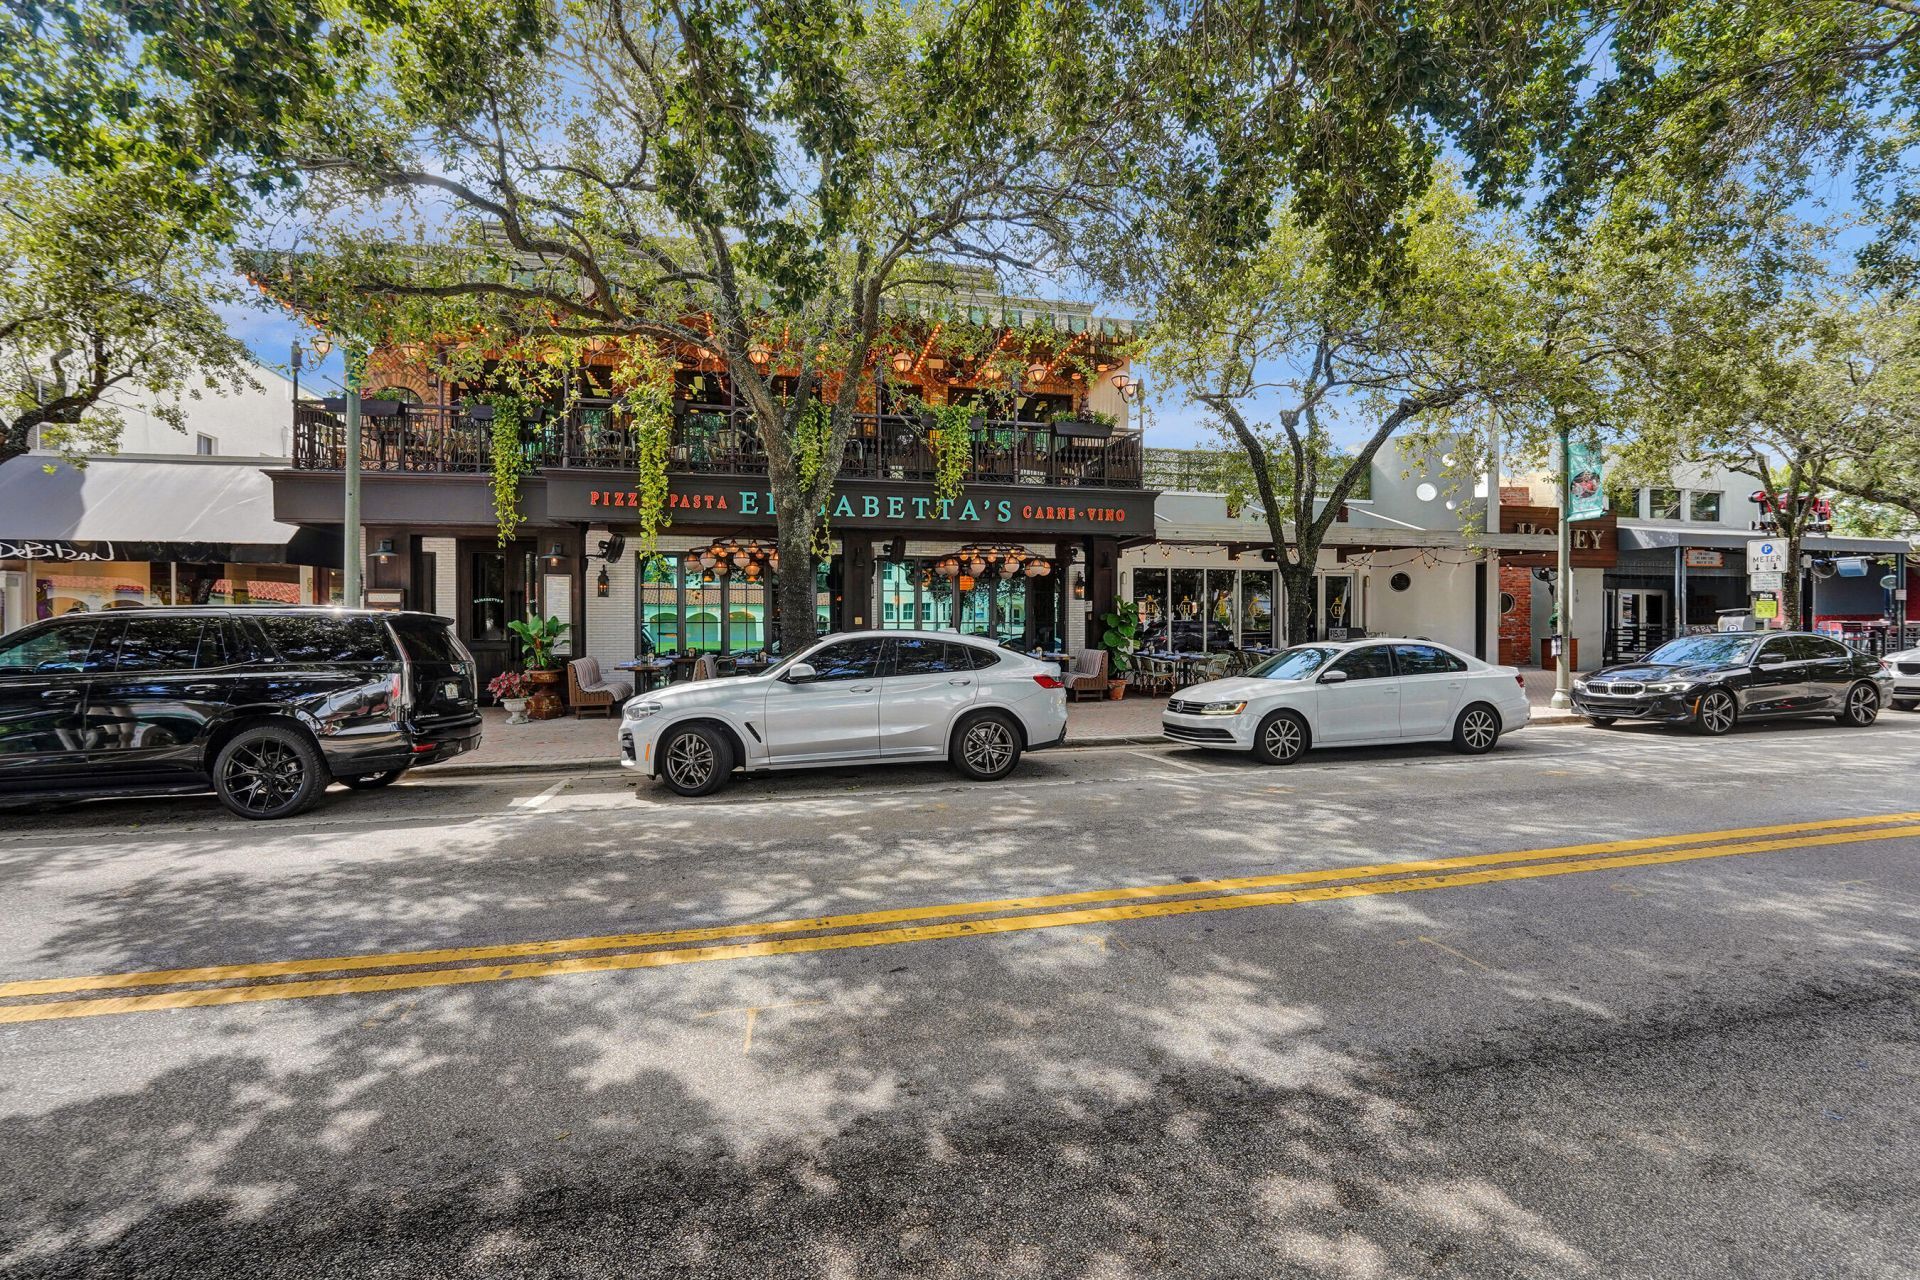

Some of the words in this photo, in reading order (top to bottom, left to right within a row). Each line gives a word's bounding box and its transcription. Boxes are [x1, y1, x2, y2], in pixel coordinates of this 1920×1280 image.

[591, 492, 640, 507] PIZZ
[670, 494, 727, 509] PASTA
[739, 491, 1011, 522] ELABETTA'S
[1023, 505, 1075, 520] CARNE
[1087, 508, 1125, 522] VINO
[1752, 555, 1781, 563] METER
